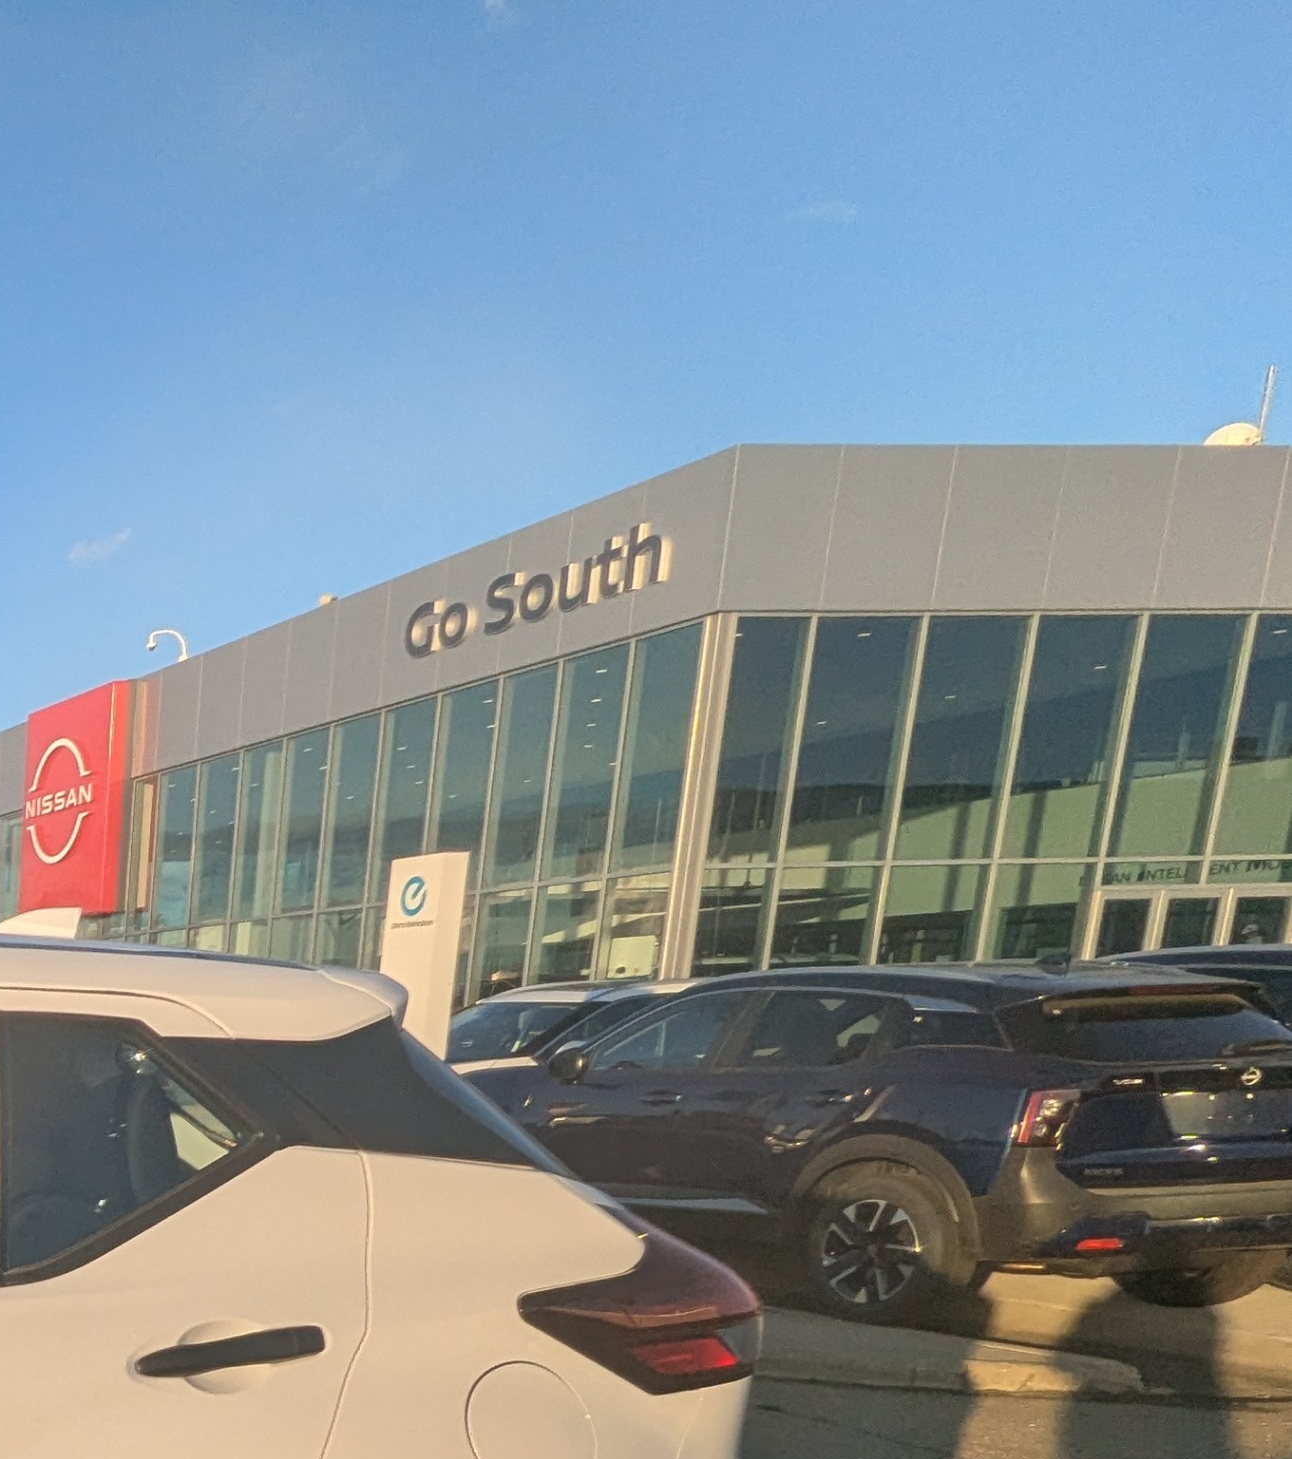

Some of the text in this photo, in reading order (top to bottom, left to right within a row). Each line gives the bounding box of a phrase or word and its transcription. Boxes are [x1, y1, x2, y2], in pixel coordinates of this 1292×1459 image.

[405, 521, 674, 659] Go South
[24, 783, 94, 819] NISSAN
